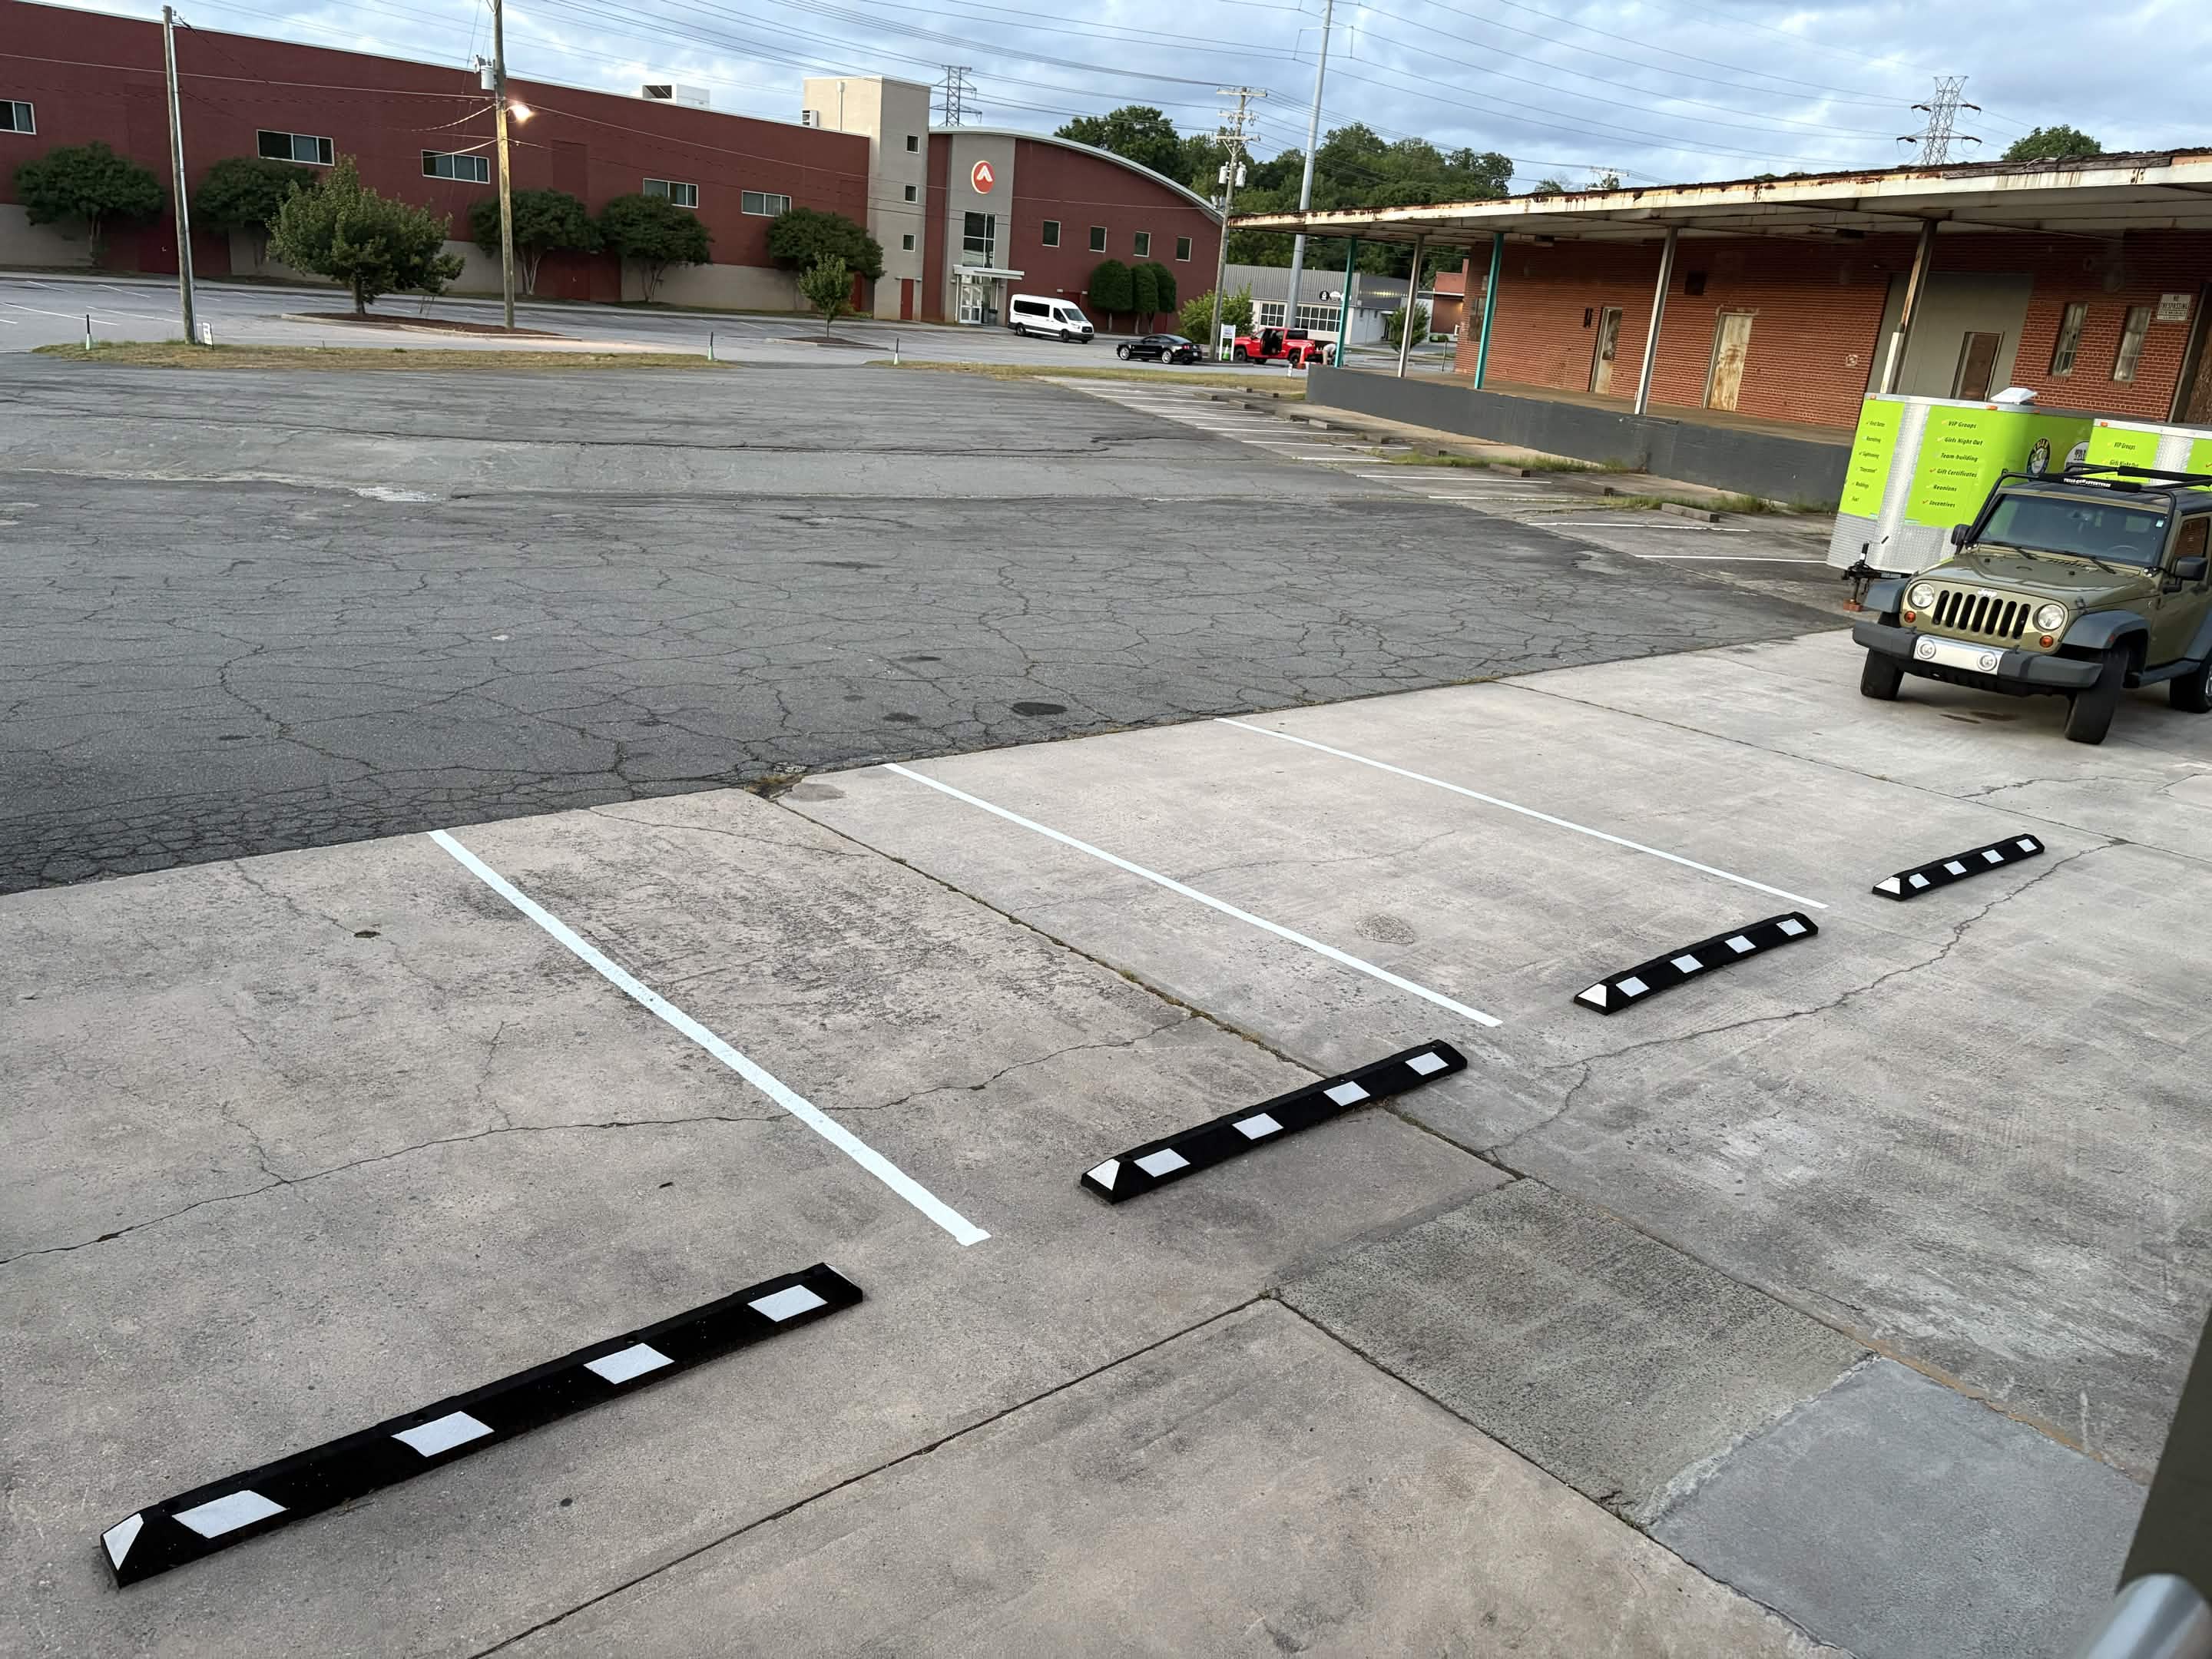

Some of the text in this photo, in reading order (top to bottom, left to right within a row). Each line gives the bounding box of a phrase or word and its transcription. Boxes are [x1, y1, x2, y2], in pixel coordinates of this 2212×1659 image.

[1947, 469, 1978, 478] Certificates
[1933, 484, 1958, 492] Reunions
[1977, 588, 1998, 598] Jeep
